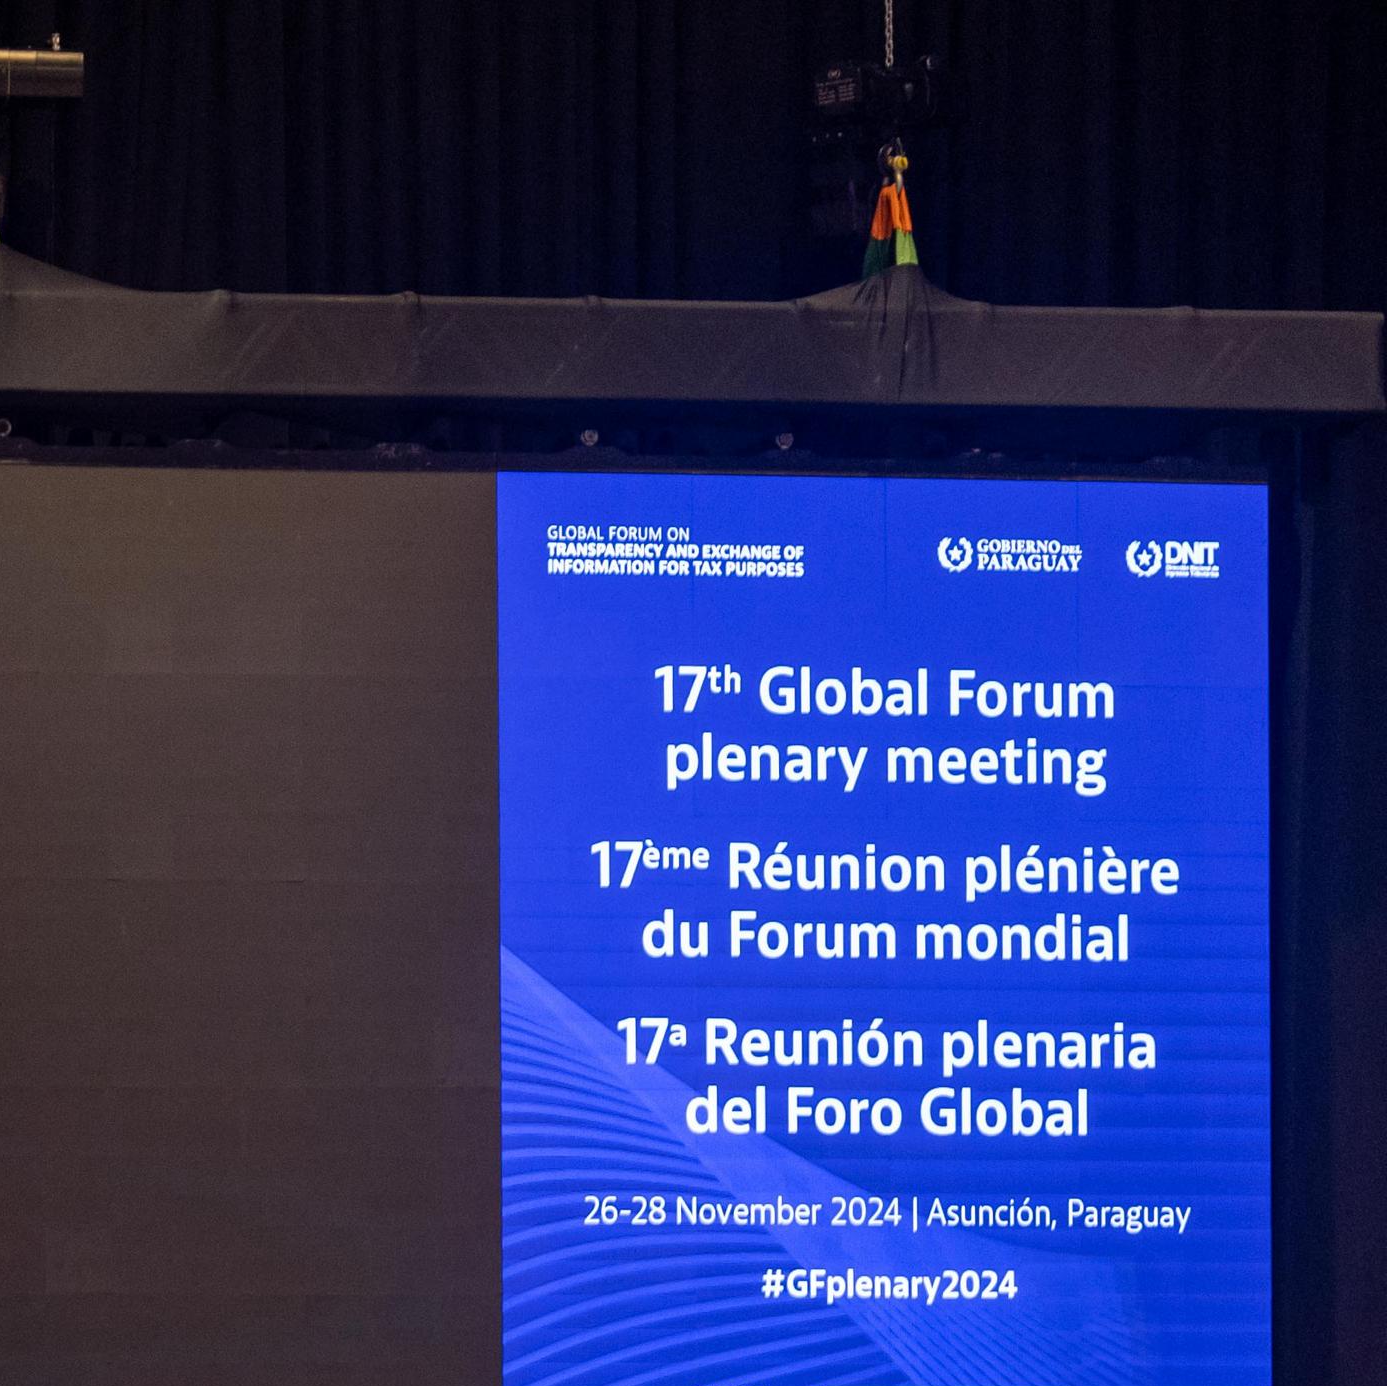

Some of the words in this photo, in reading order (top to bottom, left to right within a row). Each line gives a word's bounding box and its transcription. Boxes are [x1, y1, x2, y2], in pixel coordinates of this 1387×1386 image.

[547, 525, 604, 540] GLOBAL
[609, 527, 662, 541] FORUM
[667, 528, 690, 541] ON
[977, 539, 1061, 554] GOBIERNO
[1062, 545, 1082, 554] DEL
[547, 543, 663, 558] TRANSPARENCY
[666, 544, 699, 559] AND
[702, 545, 781, 560] EXCHANGE
[784, 546, 804, 560] OF
[547, 559, 655, 575] INFORMATION
[659, 560, 689, 575] FOR
[692, 561, 722, 576] TAX
[726, 562, 804, 577] PURPOSES
[977, 554, 1082, 572] PARAGUAY
[1165, 541, 1219, 565] DNIT
[655, 664, 741, 712] 17th
[760, 666, 927, 716] Global
[950, 670, 1114, 718] Forum
[667, 732, 868, 791] plenary
[888, 738, 1106, 796] meeting
[730, 842, 944, 891] Réunion
[966, 845, 1179, 901] plénière
[643, 909, 708, 957] du
[731, 911, 896, 958] Forum
[917, 913, 1128, 961] mondial
[706, 1018, 922, 1066] Reunión
[943, 1020, 1155, 1077] plenaria
[686, 1086, 765, 1134] del
[788, 1087, 901, 1135] Foro
[921, 1087, 1087, 1136] Global
[584, 1196, 666, 1225] 26-28
[677, 1196, 822, 1225] November
[831, 1197, 902, 1226] 2024
[927, 1198, 1056, 1230] Asunción,
[1069, 1199, 1190, 1233] Paraguay
[762, 1269, 1018, 1305] #GFplenary2024
